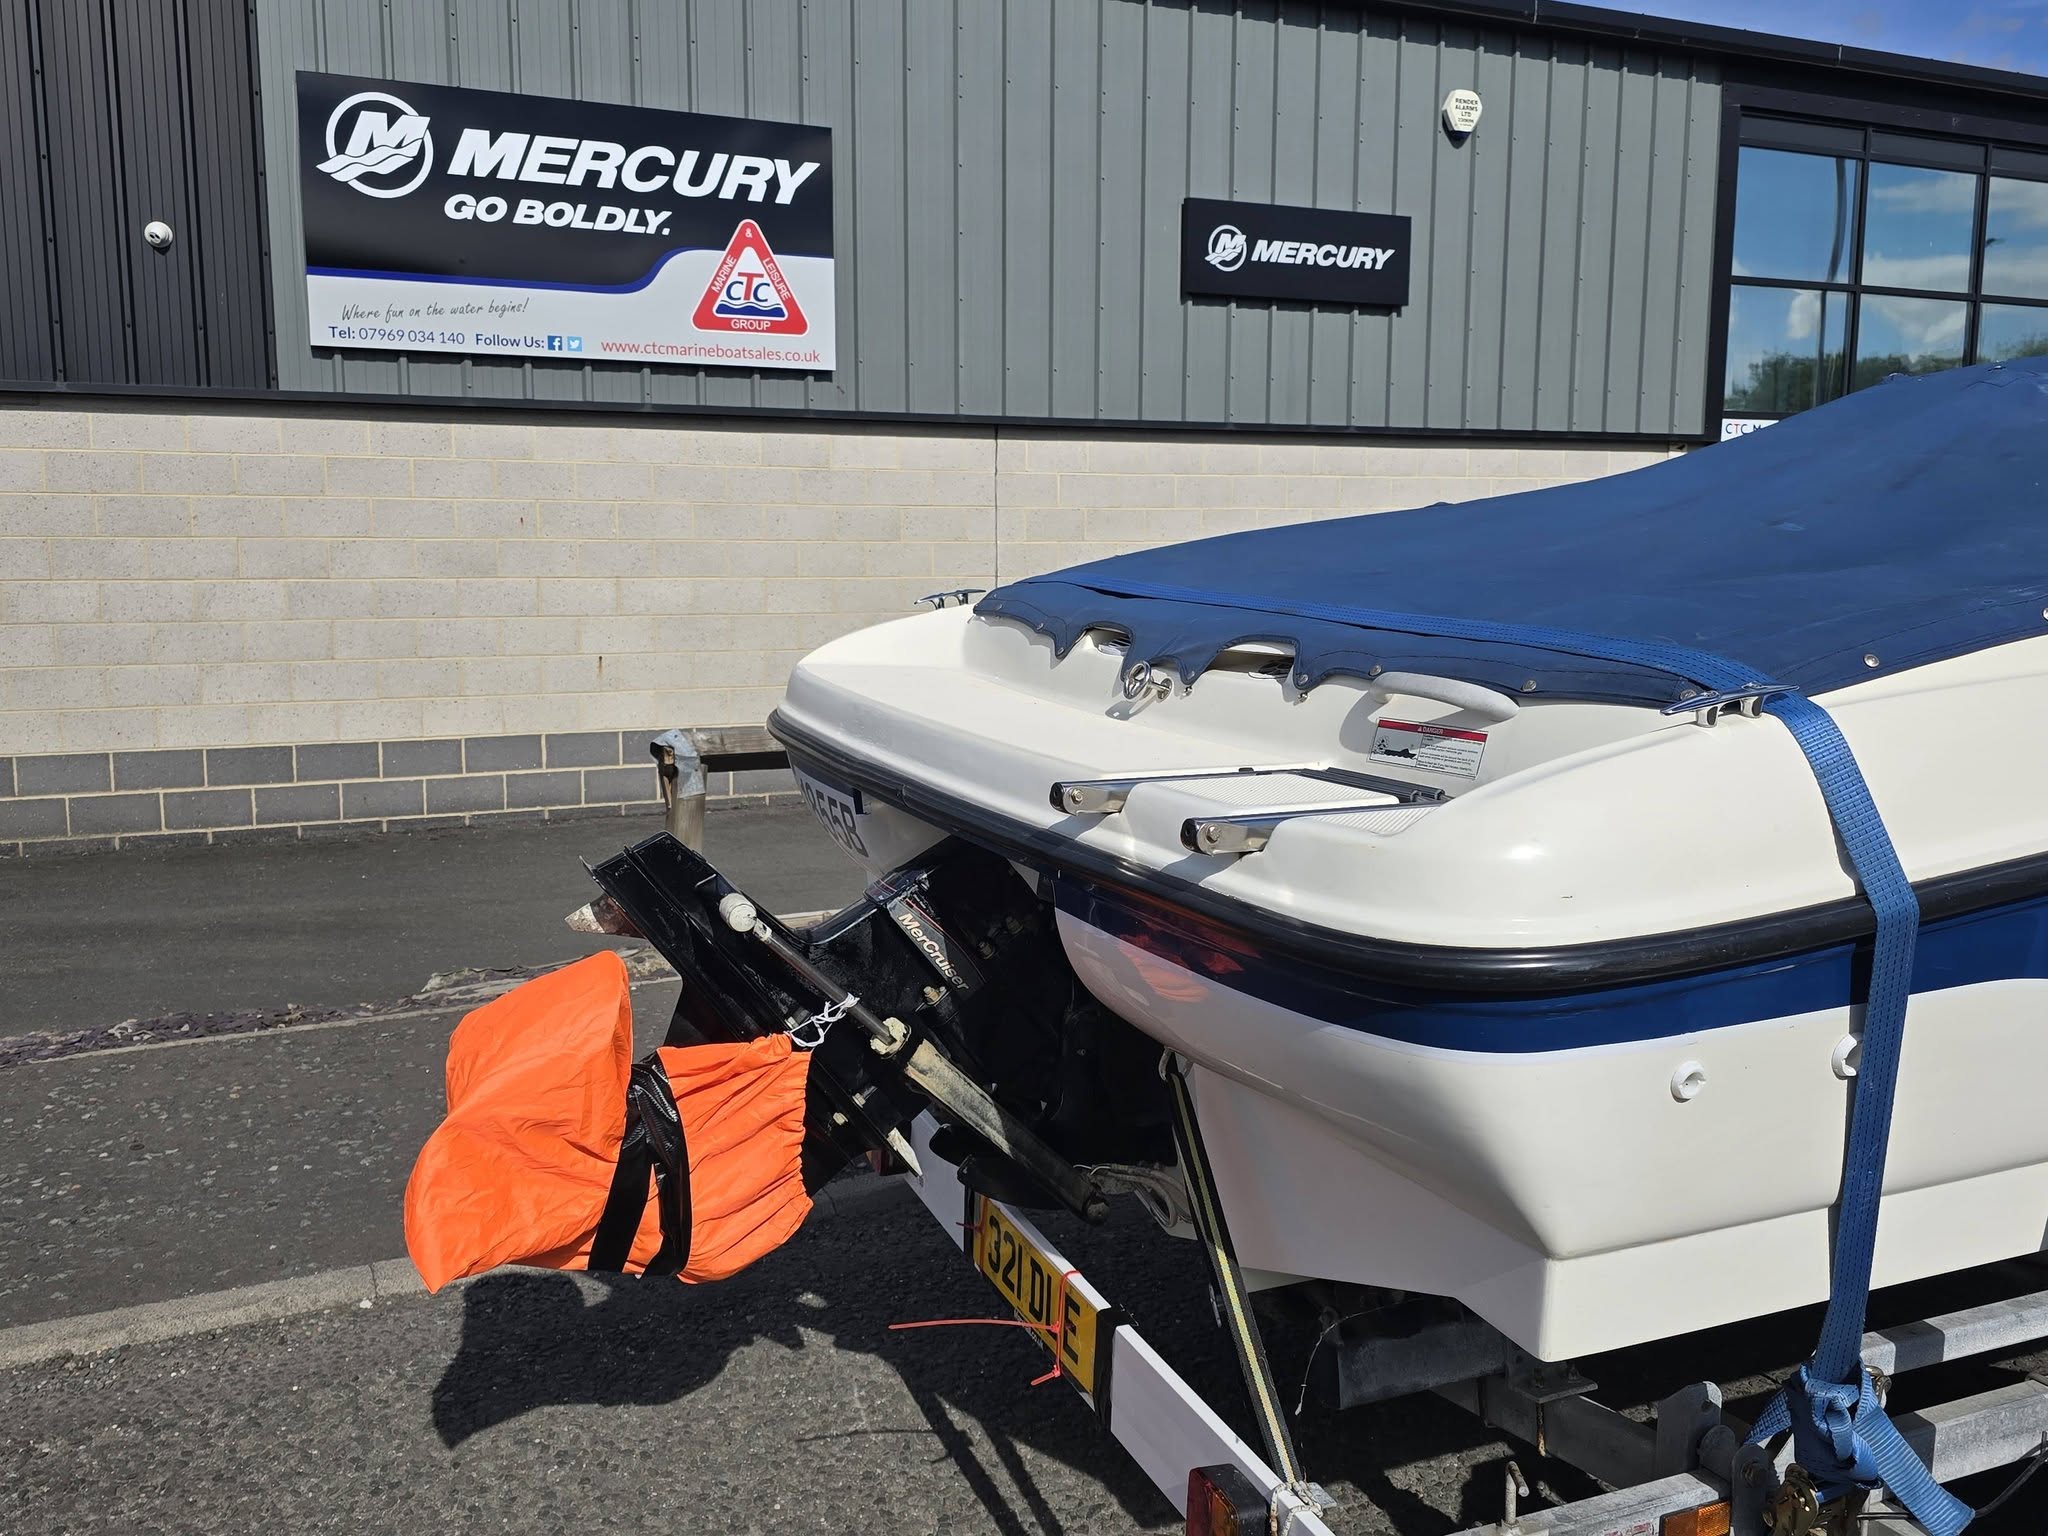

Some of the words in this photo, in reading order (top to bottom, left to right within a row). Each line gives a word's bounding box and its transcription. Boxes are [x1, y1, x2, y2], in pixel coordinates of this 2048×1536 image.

[447, 128, 820, 204] MERCURY
[444, 193, 507, 222] GO
[512, 199, 672, 236] BOLDLY.
[745, 228, 752, 238] &
[1251, 239, 1396, 270] MERCURY
[711, 255, 737, 293] MARINE
[763, 257, 791, 301] LEISURE
[342, 304, 380, 321] Where
[386, 304, 403, 323] fun
[409, 308, 421, 317] on
[427, 302, 445, 316] the
[450, 304, 483, 315] water
[488, 297, 530, 318] begins!
[329, 326, 355, 339] Tel:
[358, 328, 404, 342] 07969
[408, 330, 435, 343] 034
[440, 332, 465, 345] 140
[475, 333, 521, 348] Follow
[524, 336, 545, 349] Us:
[731, 319, 771, 331] GROUP
[601, 340, 820, 363] www.ctcmarineboatsales.co.uk
[1725, 423, 1748, 434] CTC
[1422, 726, 1444, 735] DANGER
[898, 913, 969, 990] MerCruiser
[988, 1214, 1023, 1302] 321
